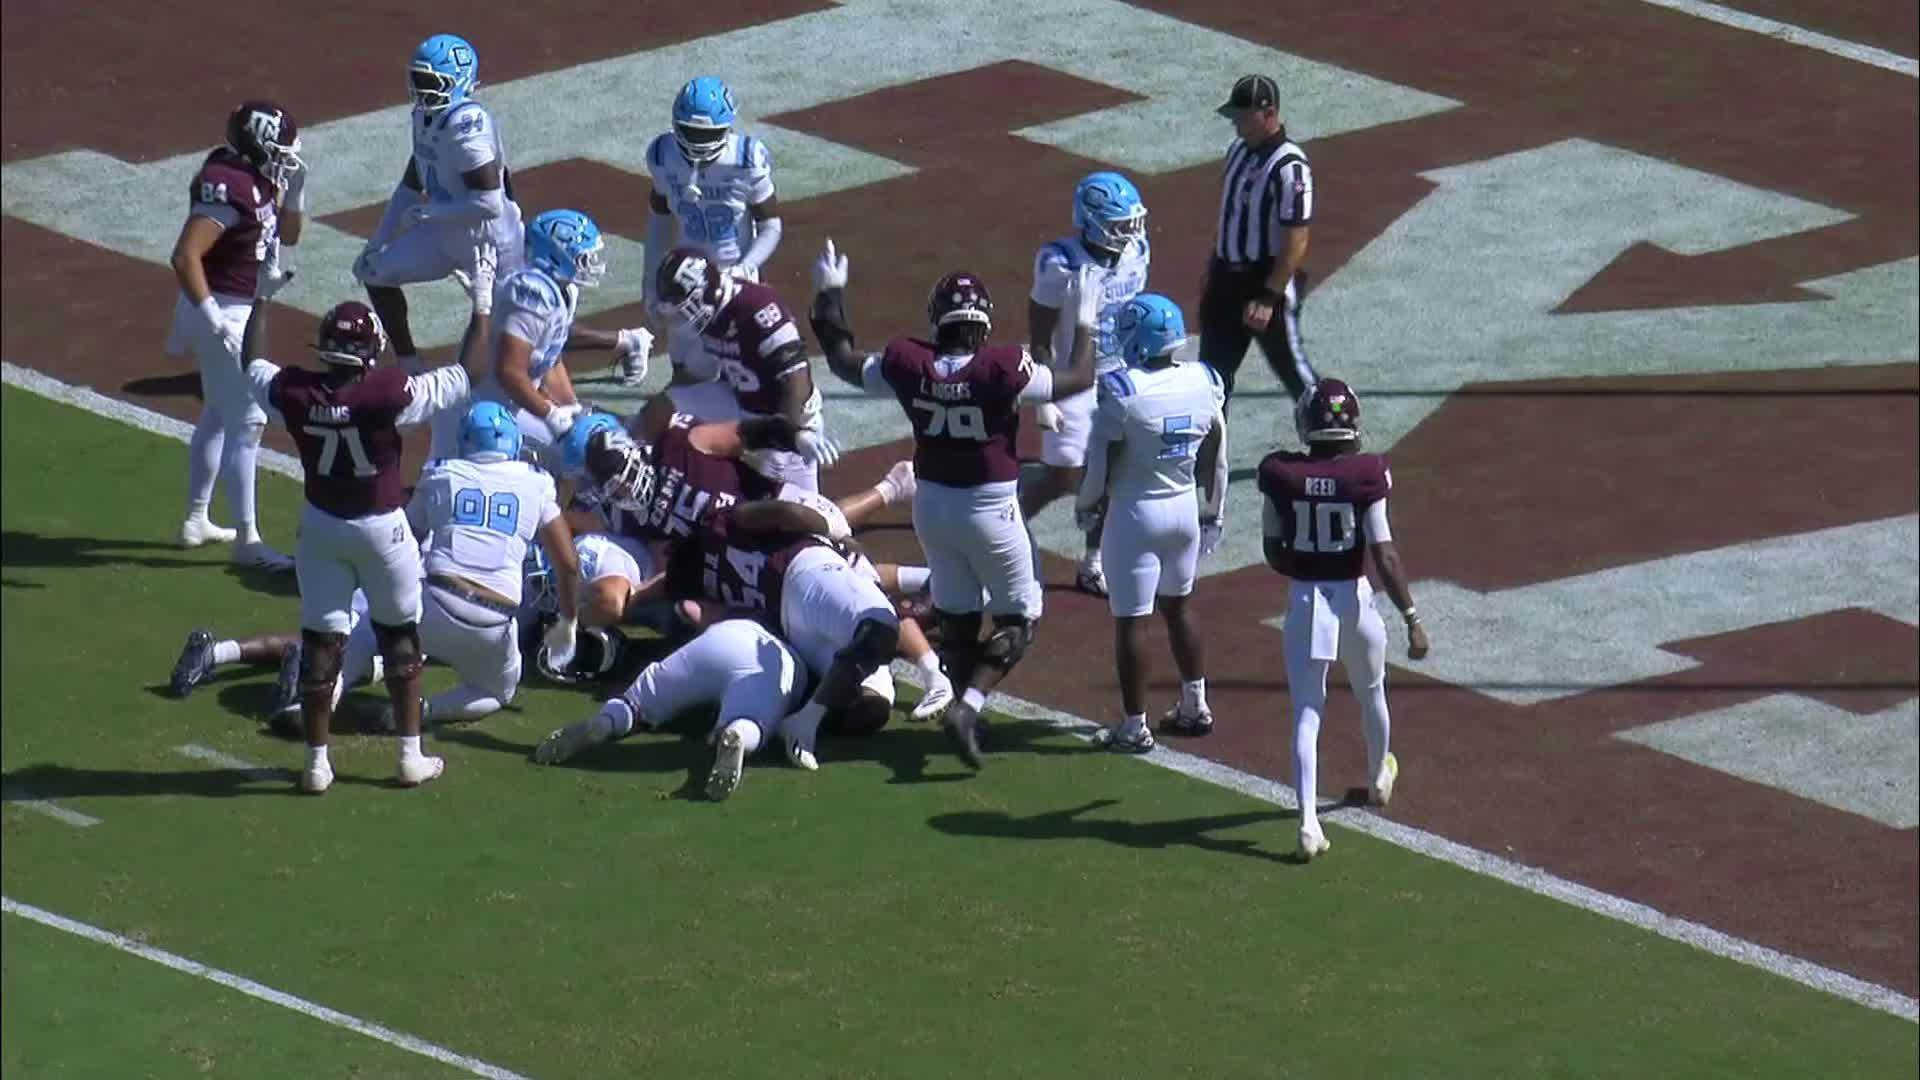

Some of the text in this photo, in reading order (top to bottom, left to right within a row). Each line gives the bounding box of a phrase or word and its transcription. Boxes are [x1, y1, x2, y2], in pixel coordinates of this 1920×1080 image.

[202, 182, 228, 203] 84
[309, 405, 351, 423] ADAMS
[912, 398, 990, 440] 79
[303, 426, 378, 476] 71
[1305, 477, 1337, 497] REED
[1294, 501, 1356, 552] 10
